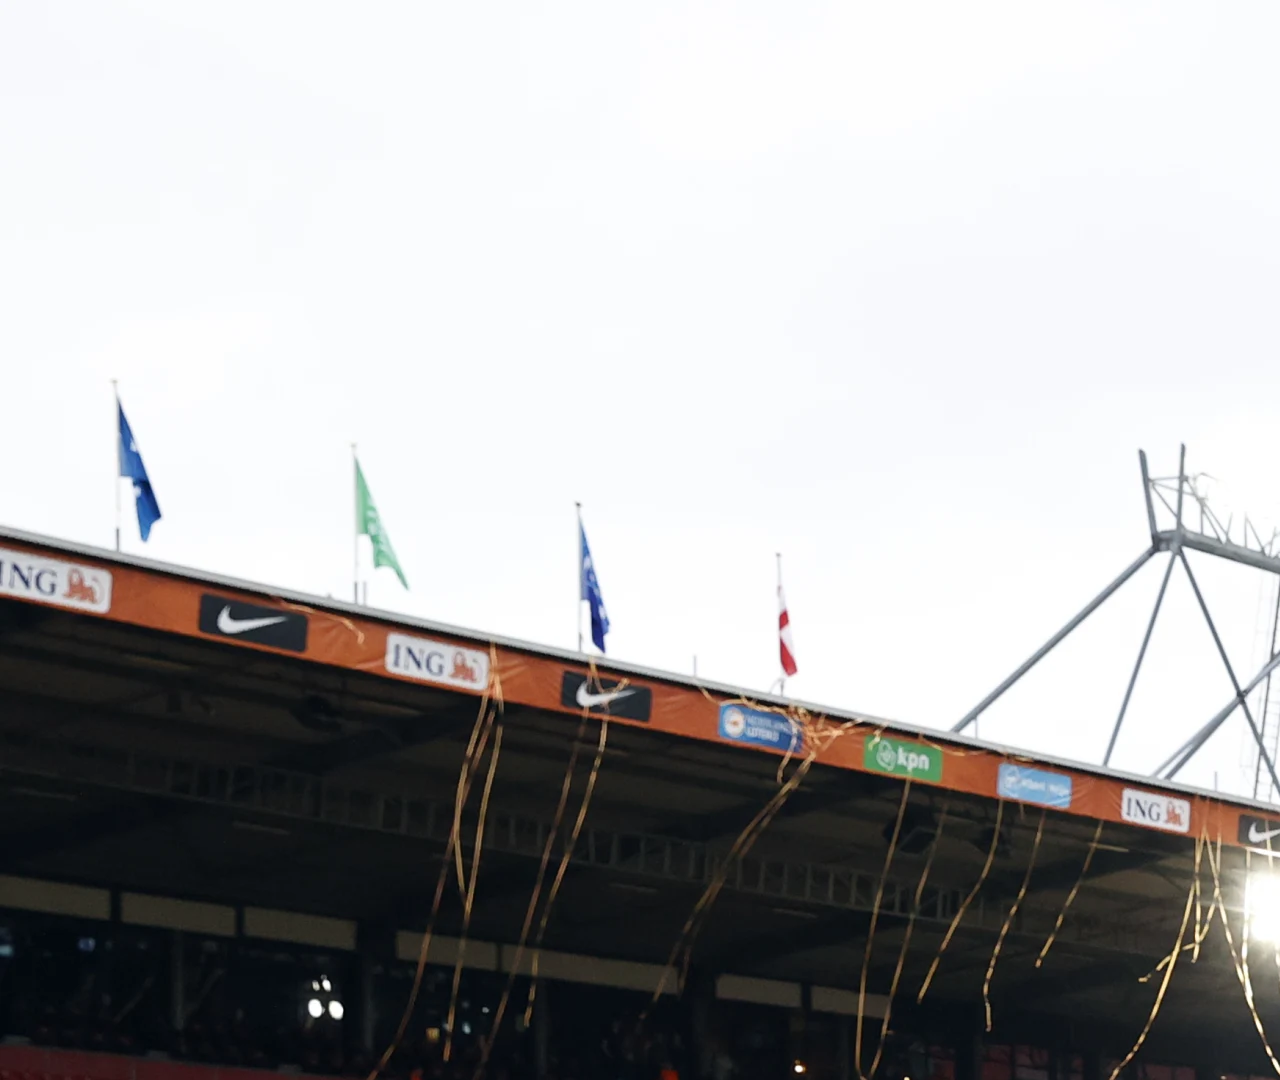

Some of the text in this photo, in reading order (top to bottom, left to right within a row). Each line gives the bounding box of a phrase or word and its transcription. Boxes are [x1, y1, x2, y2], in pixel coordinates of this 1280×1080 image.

[393, 643, 445, 677] ING
[897, 747, 929, 772] kpn
[1126, 797, 1161, 822] ING
